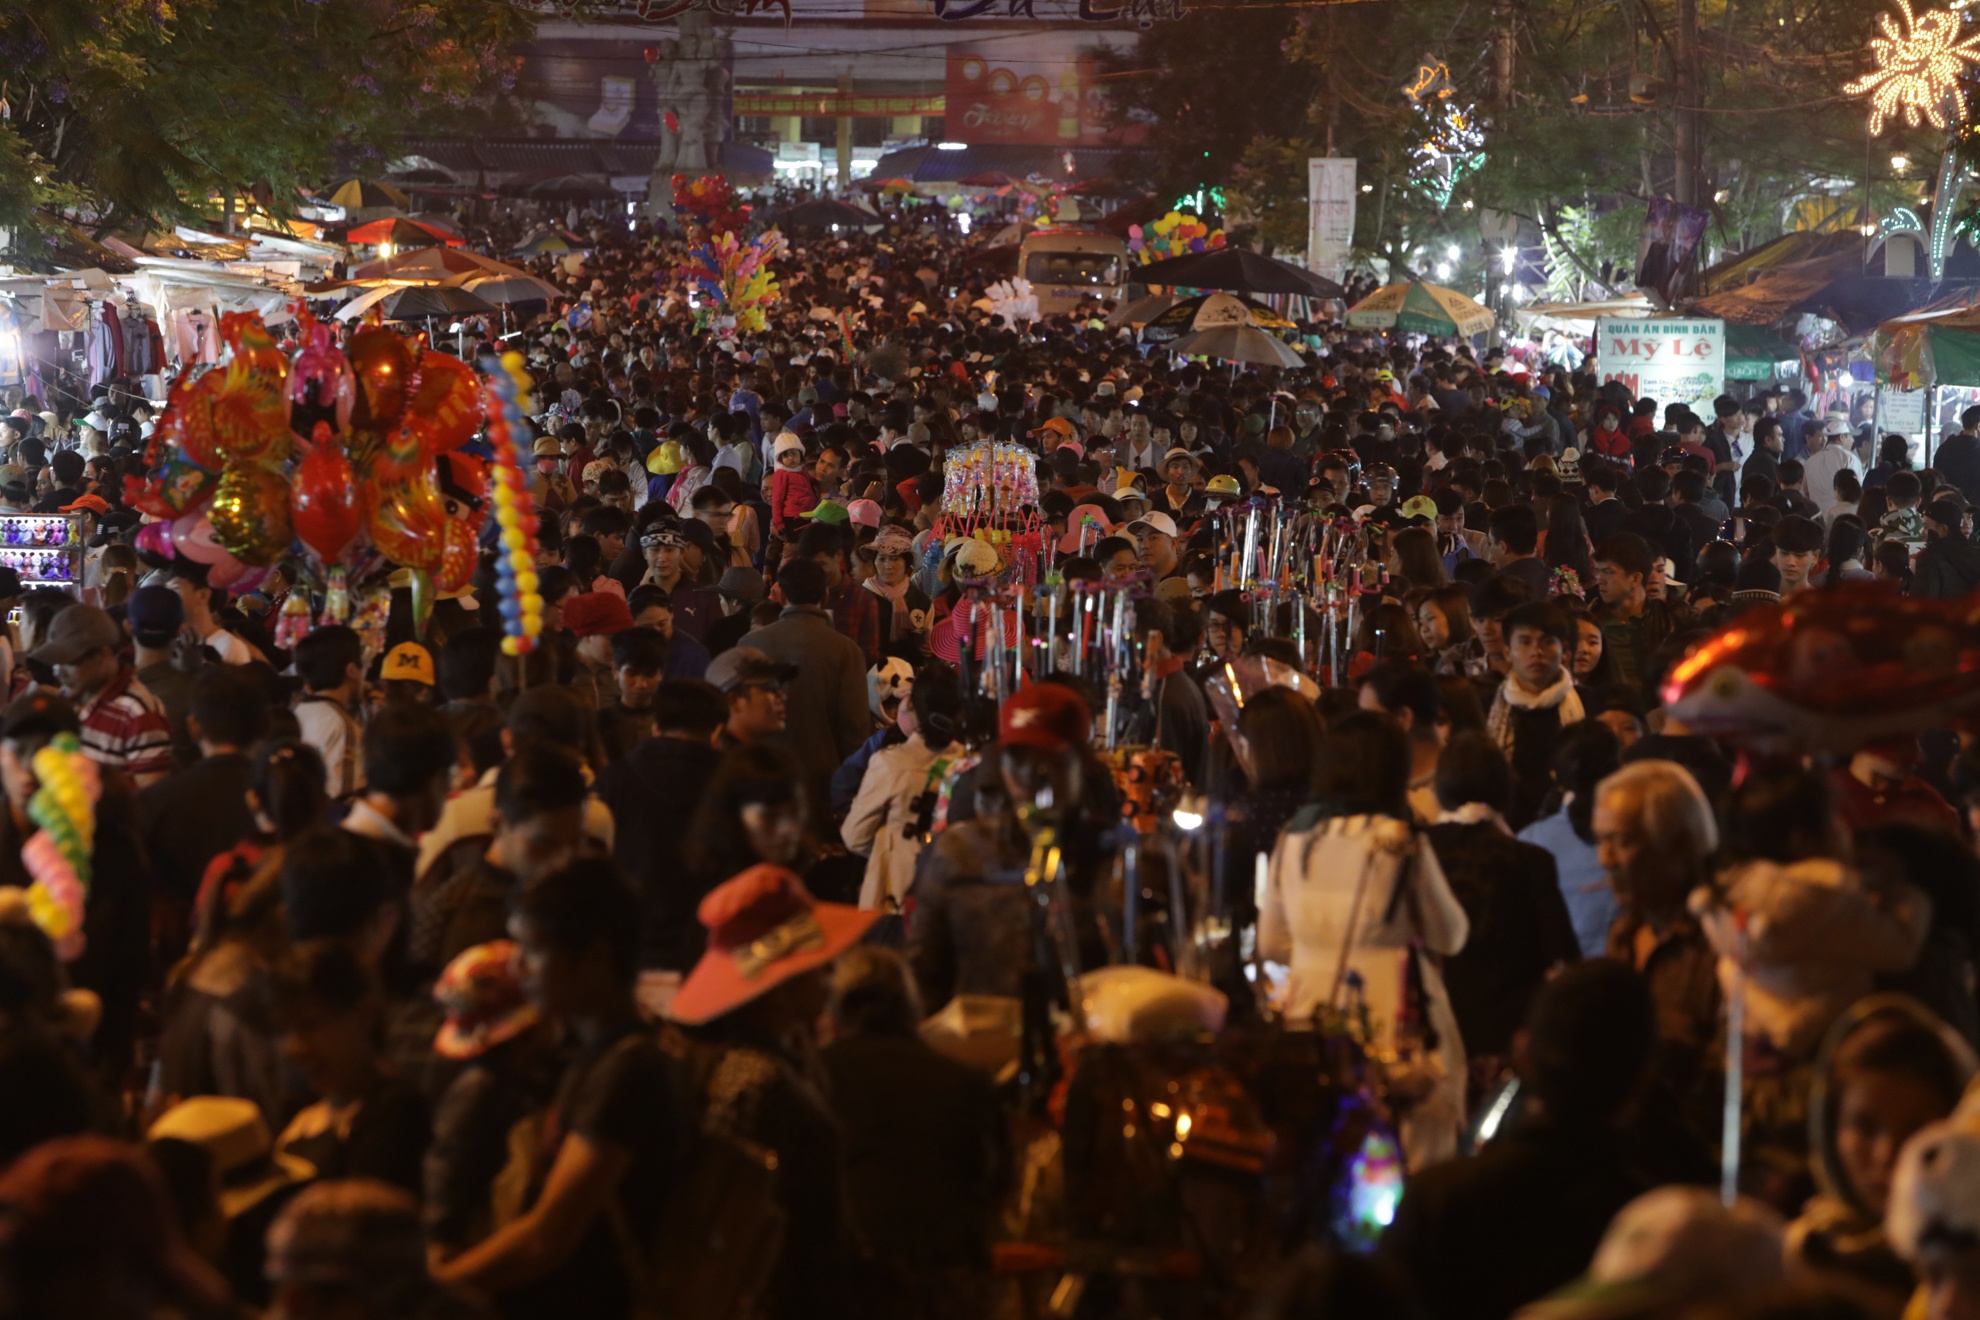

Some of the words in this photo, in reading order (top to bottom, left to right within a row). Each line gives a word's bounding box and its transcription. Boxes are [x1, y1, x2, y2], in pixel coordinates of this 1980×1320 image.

[1610, 338, 1662, 361] Mỹ
[1673, 337, 1712, 360] Lệ
[397, 653, 420, 670] M
